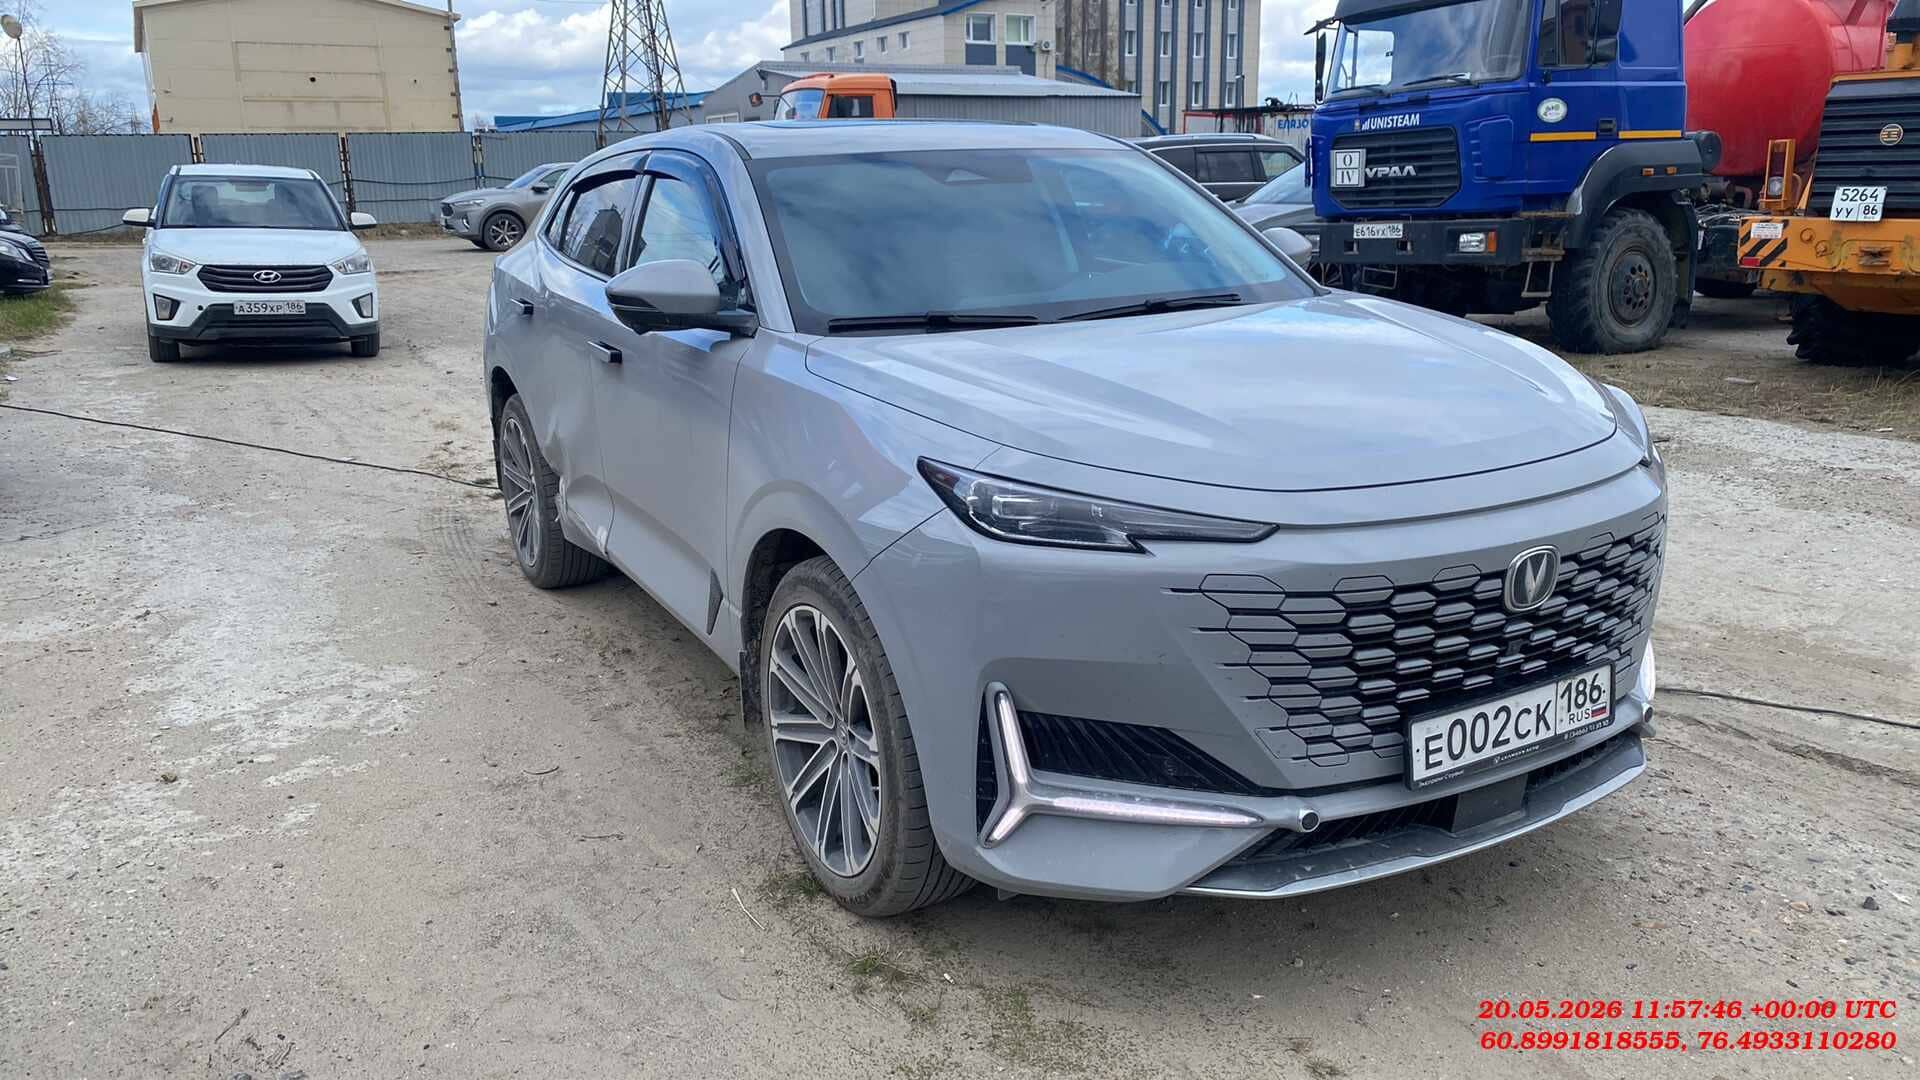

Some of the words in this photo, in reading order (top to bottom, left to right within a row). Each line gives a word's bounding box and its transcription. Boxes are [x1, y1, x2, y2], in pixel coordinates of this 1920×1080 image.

[1370, 113, 1420, 130] UNISTEAM
[1840, 188, 1879, 202] 5264
[1863, 204, 1878, 216] 86
[286, 302, 304, 310] 186
[1425, 700, 1552, 770] Е002СК
[1560, 673, 1602, 713] 186
[1568, 707, 1590, 724] RUS
